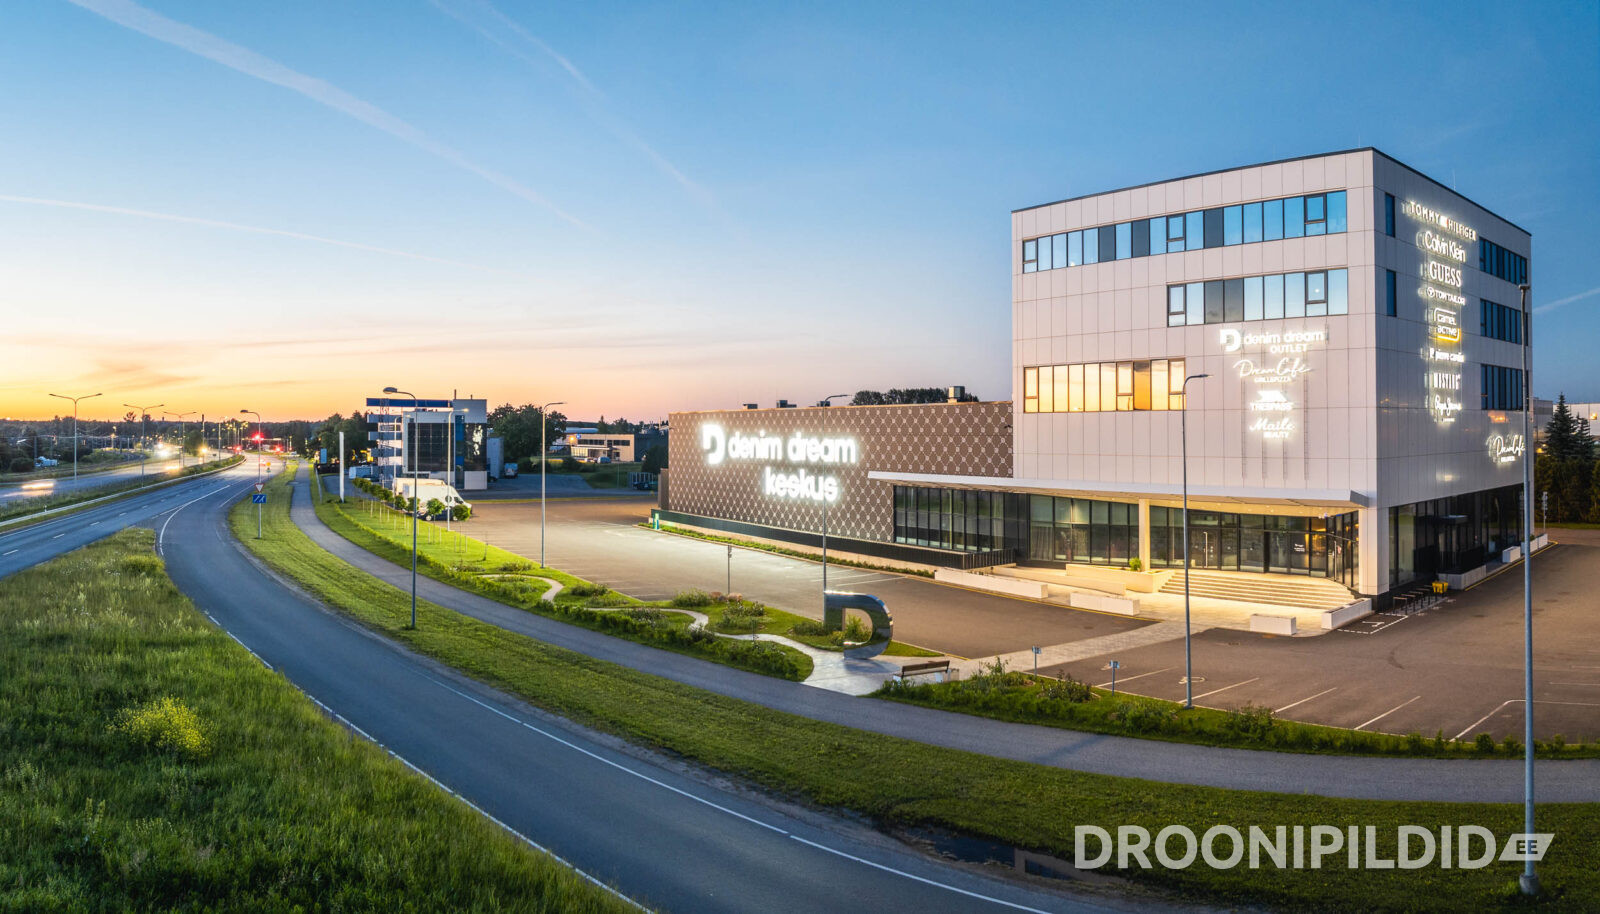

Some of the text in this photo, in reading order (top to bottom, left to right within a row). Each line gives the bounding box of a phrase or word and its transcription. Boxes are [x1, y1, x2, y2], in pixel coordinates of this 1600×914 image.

[1410, 201, 1477, 241] TOMMY HILFIGER
[1425, 231, 1466, 262] Calvin Klein
[1429, 261, 1462, 288] GUESS
[1244, 332, 1280, 345] denim
[1284, 330, 1325, 343] dream
[1270, 344, 1308, 353] OUTLET
[1233, 359, 1275, 378] Dream
[728, 430, 783, 460] denim
[787, 432, 857, 464] dream
[765, 467, 838, 501] keskus
